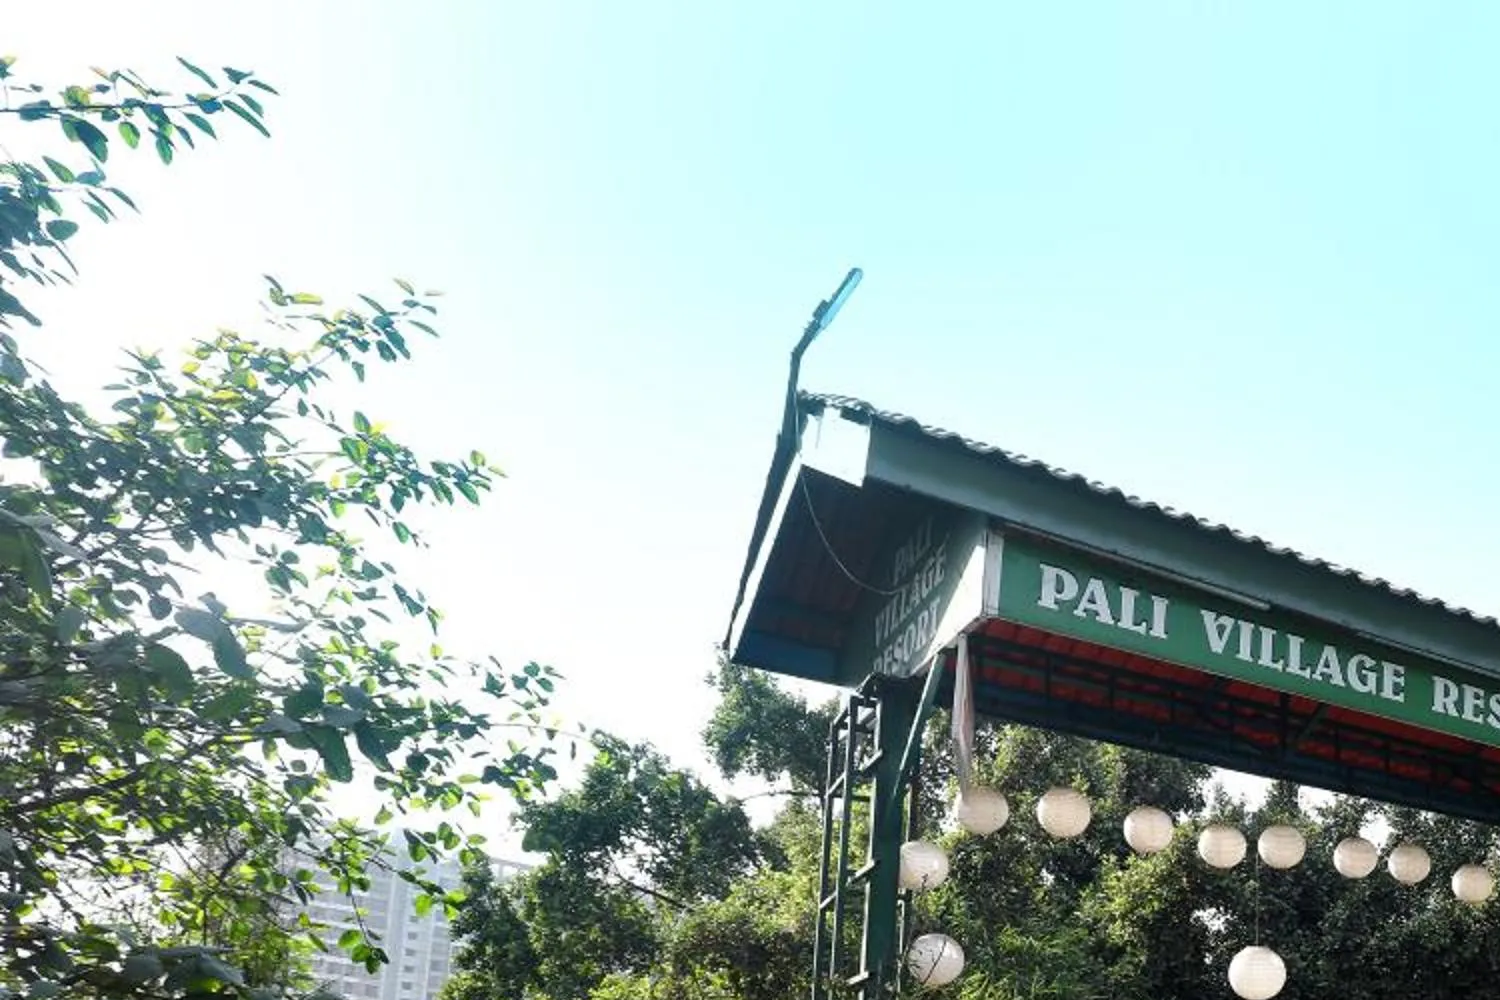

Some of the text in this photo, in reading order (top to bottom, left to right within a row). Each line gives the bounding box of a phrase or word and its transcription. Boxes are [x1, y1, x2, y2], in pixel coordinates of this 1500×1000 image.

[875, 540, 946, 649] VILLAGE
[1037, 563, 1170, 640] PALI
[1200, 609, 1405, 702] VILLAGE
